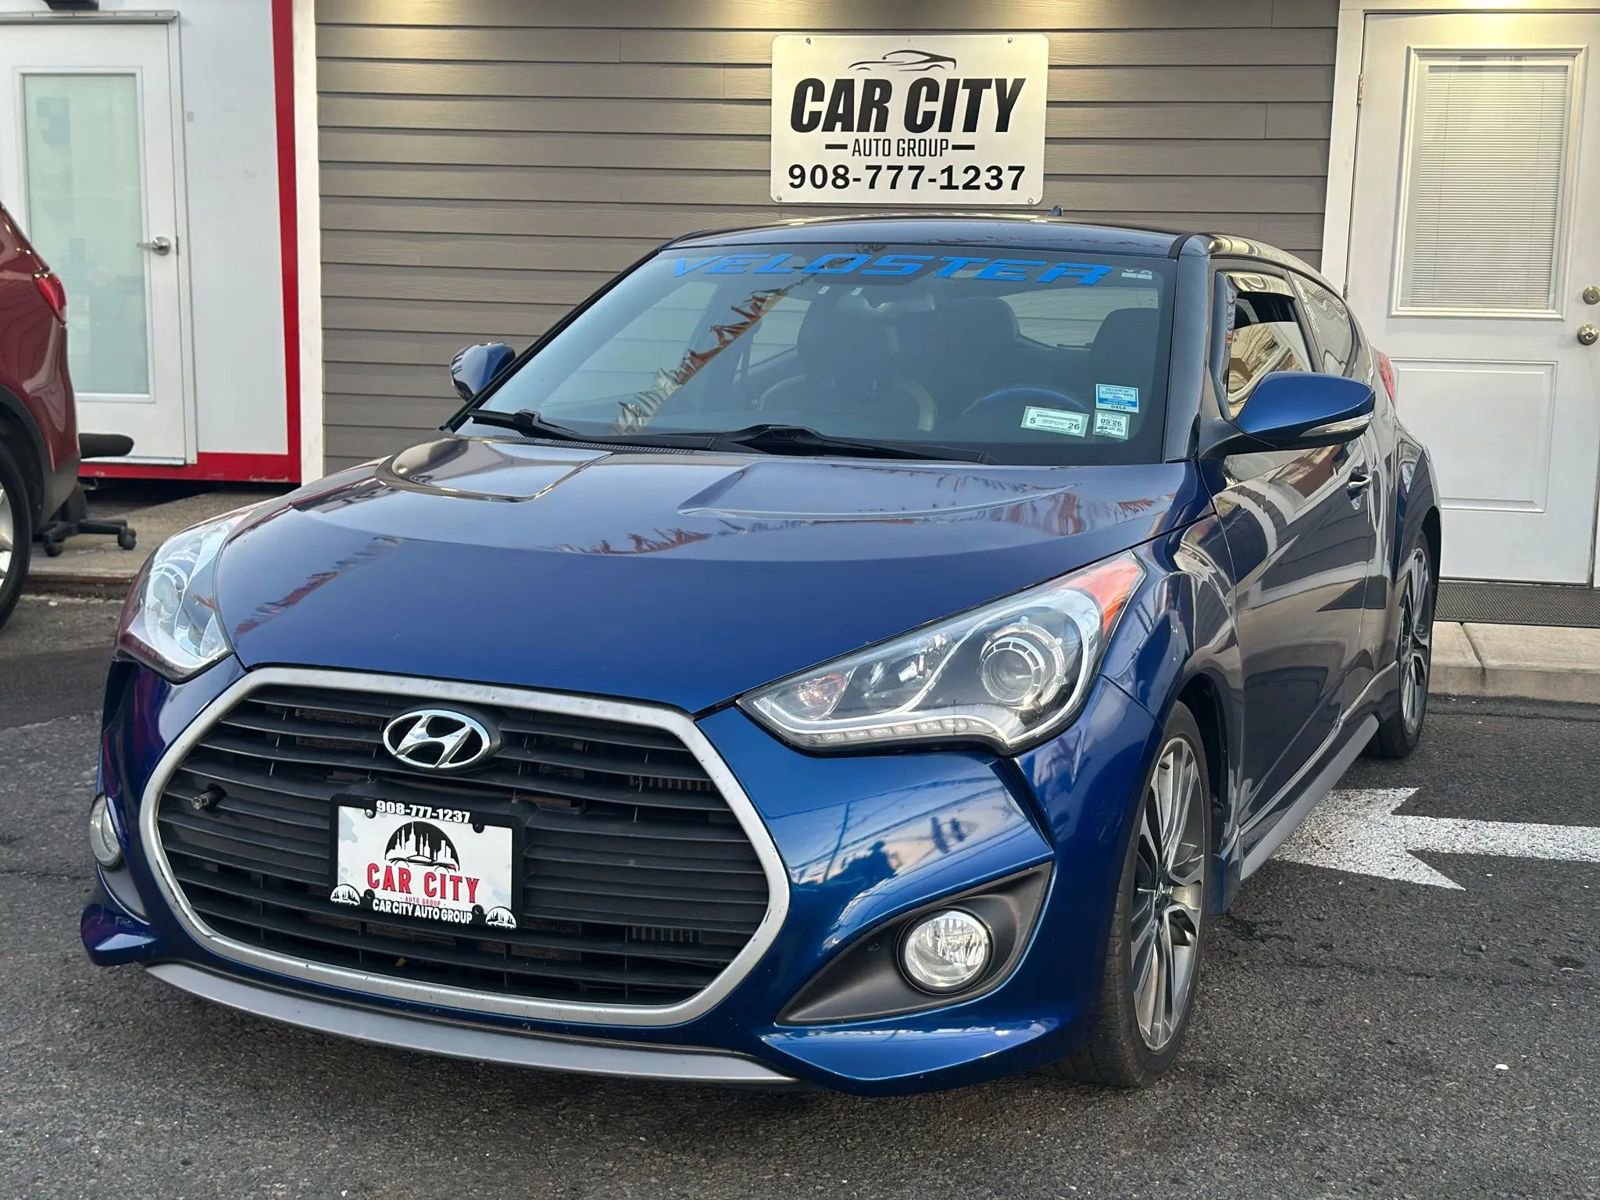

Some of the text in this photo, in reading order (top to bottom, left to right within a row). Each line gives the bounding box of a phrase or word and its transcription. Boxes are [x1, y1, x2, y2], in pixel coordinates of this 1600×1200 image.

[790, 77, 1026, 134] CAR CITY
[852, 138, 949, 158] AUTO GROUP
[788, 164, 1026, 191] 908-777-1237
[673, 253, 1112, 286] VELOSTER
[376, 800, 470, 823] 908-777-1237
[367, 863, 479, 903] CAR CITY
[372, 898, 473, 924] CAR CITY AUTO GROUP
[405, 896, 420, 904] AUTO
